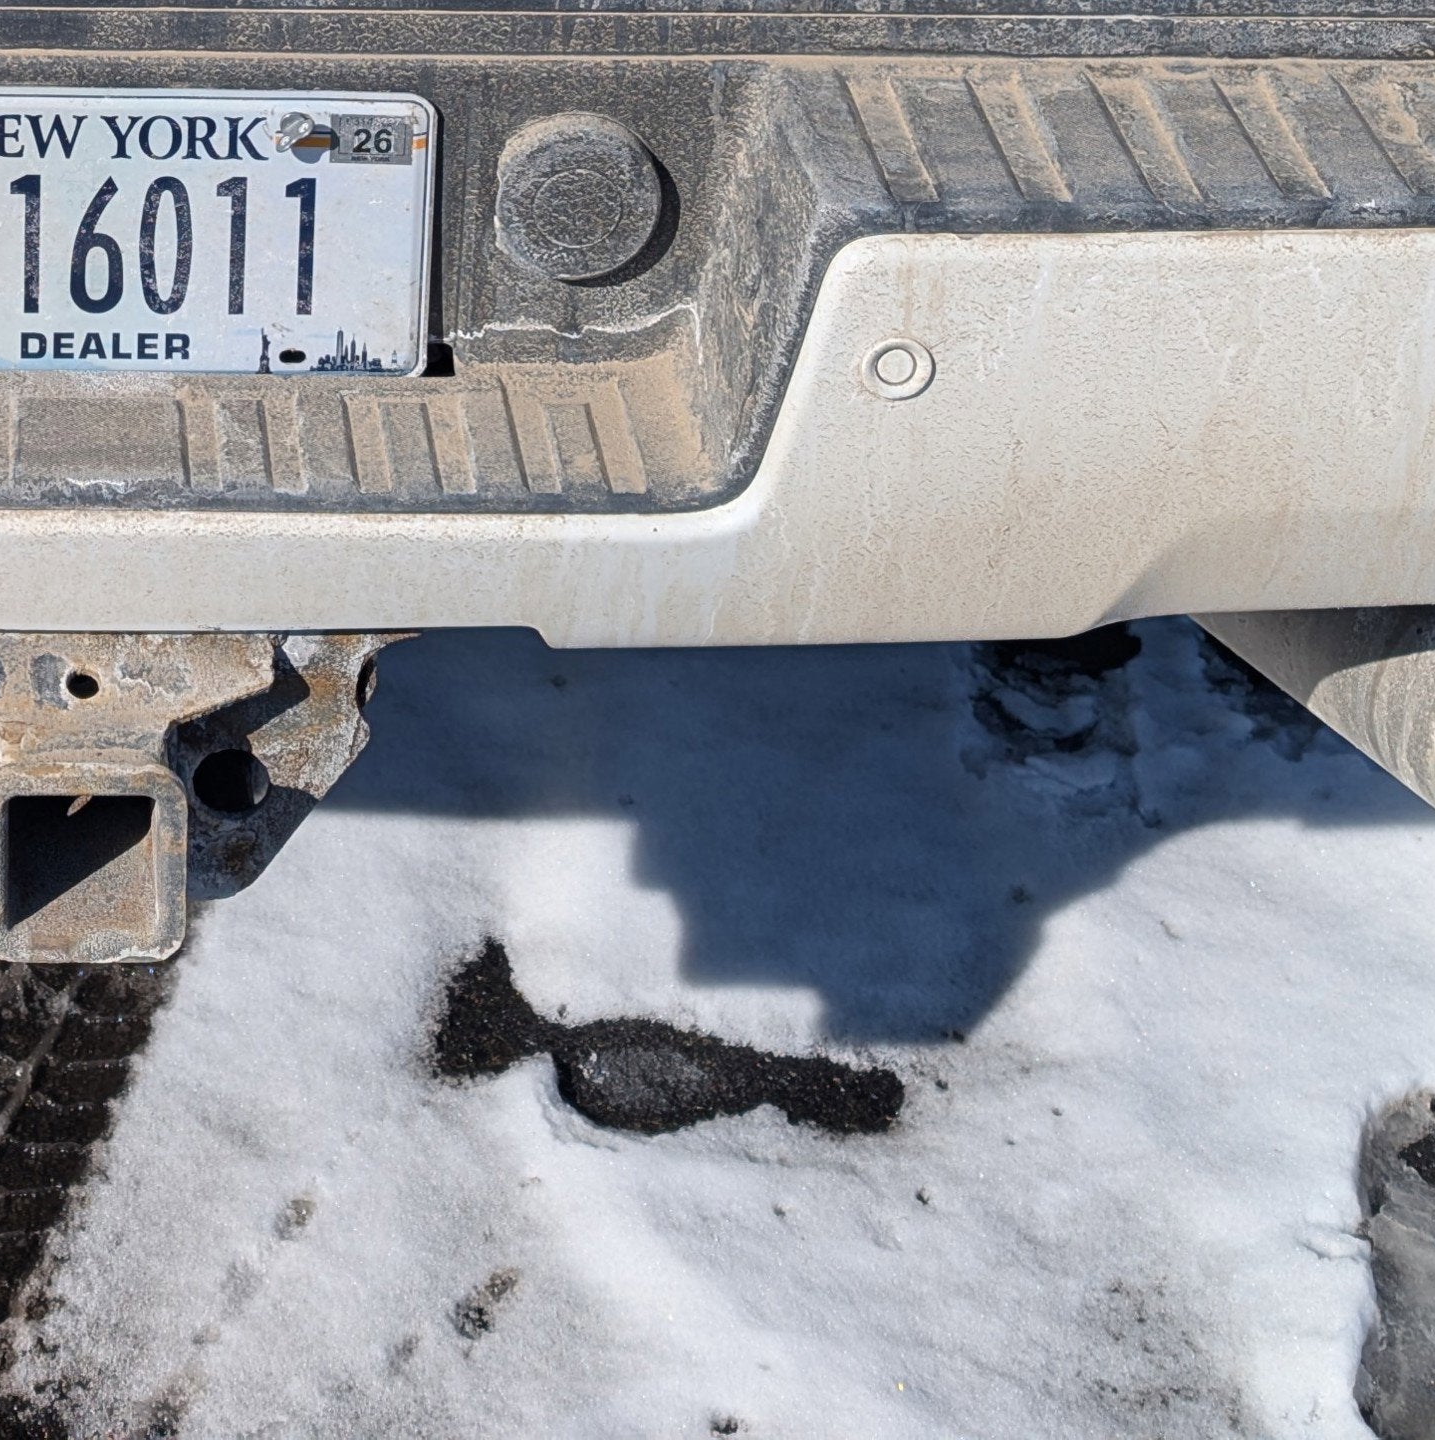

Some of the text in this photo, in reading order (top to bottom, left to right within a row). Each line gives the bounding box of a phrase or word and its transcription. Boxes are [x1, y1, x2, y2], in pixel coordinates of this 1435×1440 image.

[97, 114, 269, 162] YORK
[353, 128, 392, 153] 26
[20, 332, 190, 361] DEALER
